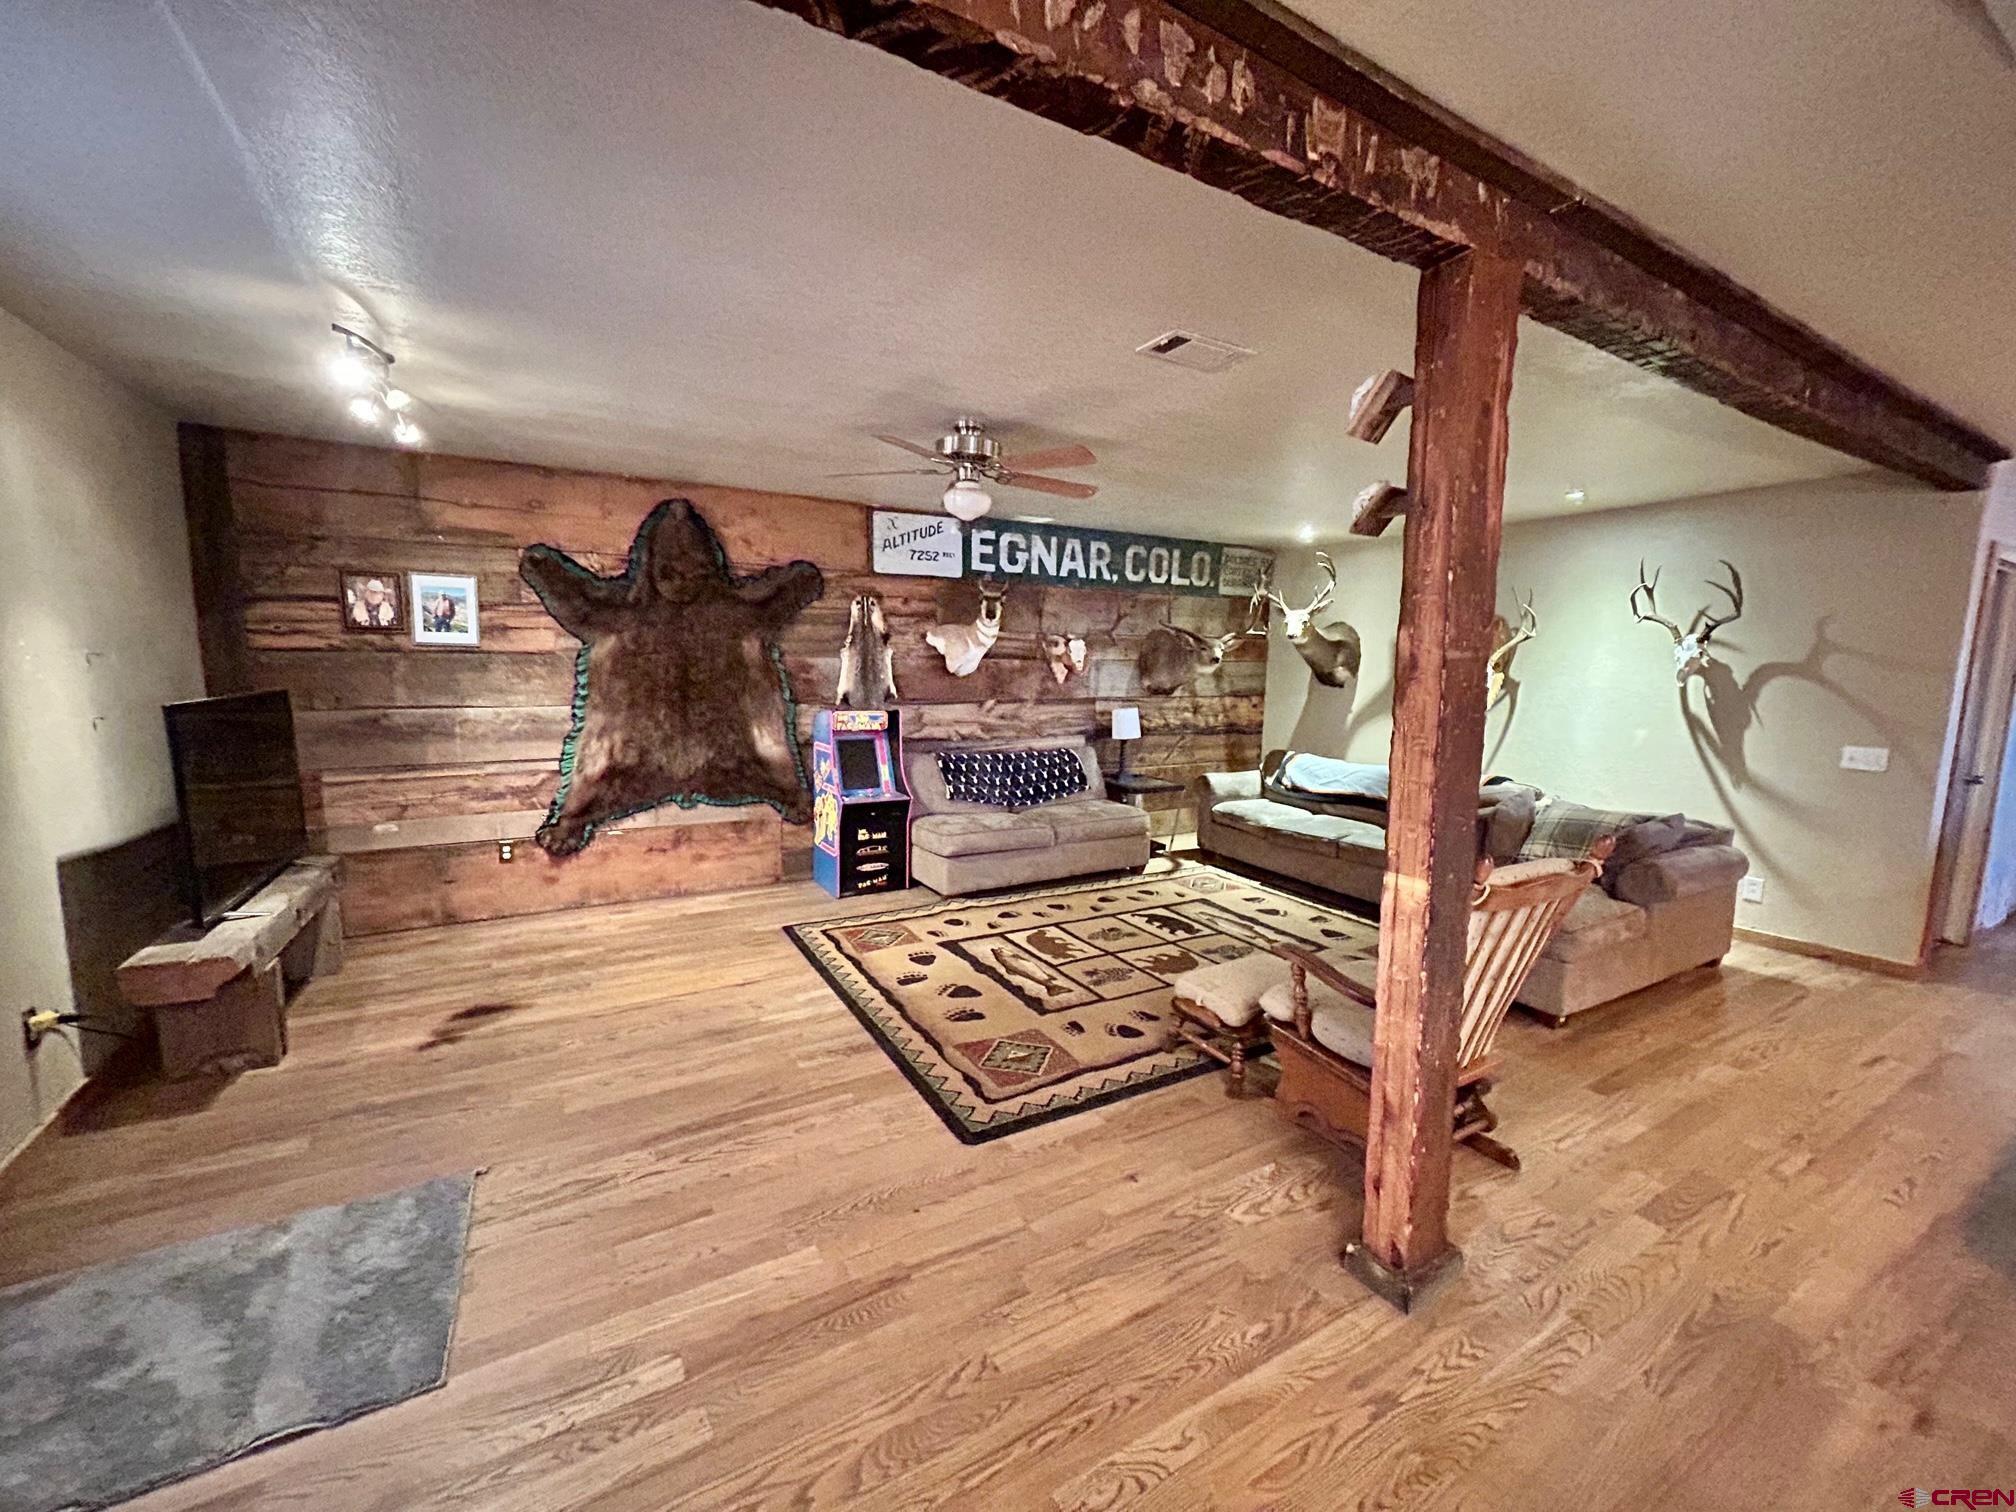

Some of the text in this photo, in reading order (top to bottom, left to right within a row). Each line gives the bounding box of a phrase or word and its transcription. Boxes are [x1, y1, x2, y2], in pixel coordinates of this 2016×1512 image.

[882, 521, 944, 552] ALTITUDE
[909, 549, 940, 562] 7252
[971, 528, 1215, 588] EGNAR, COLO.
